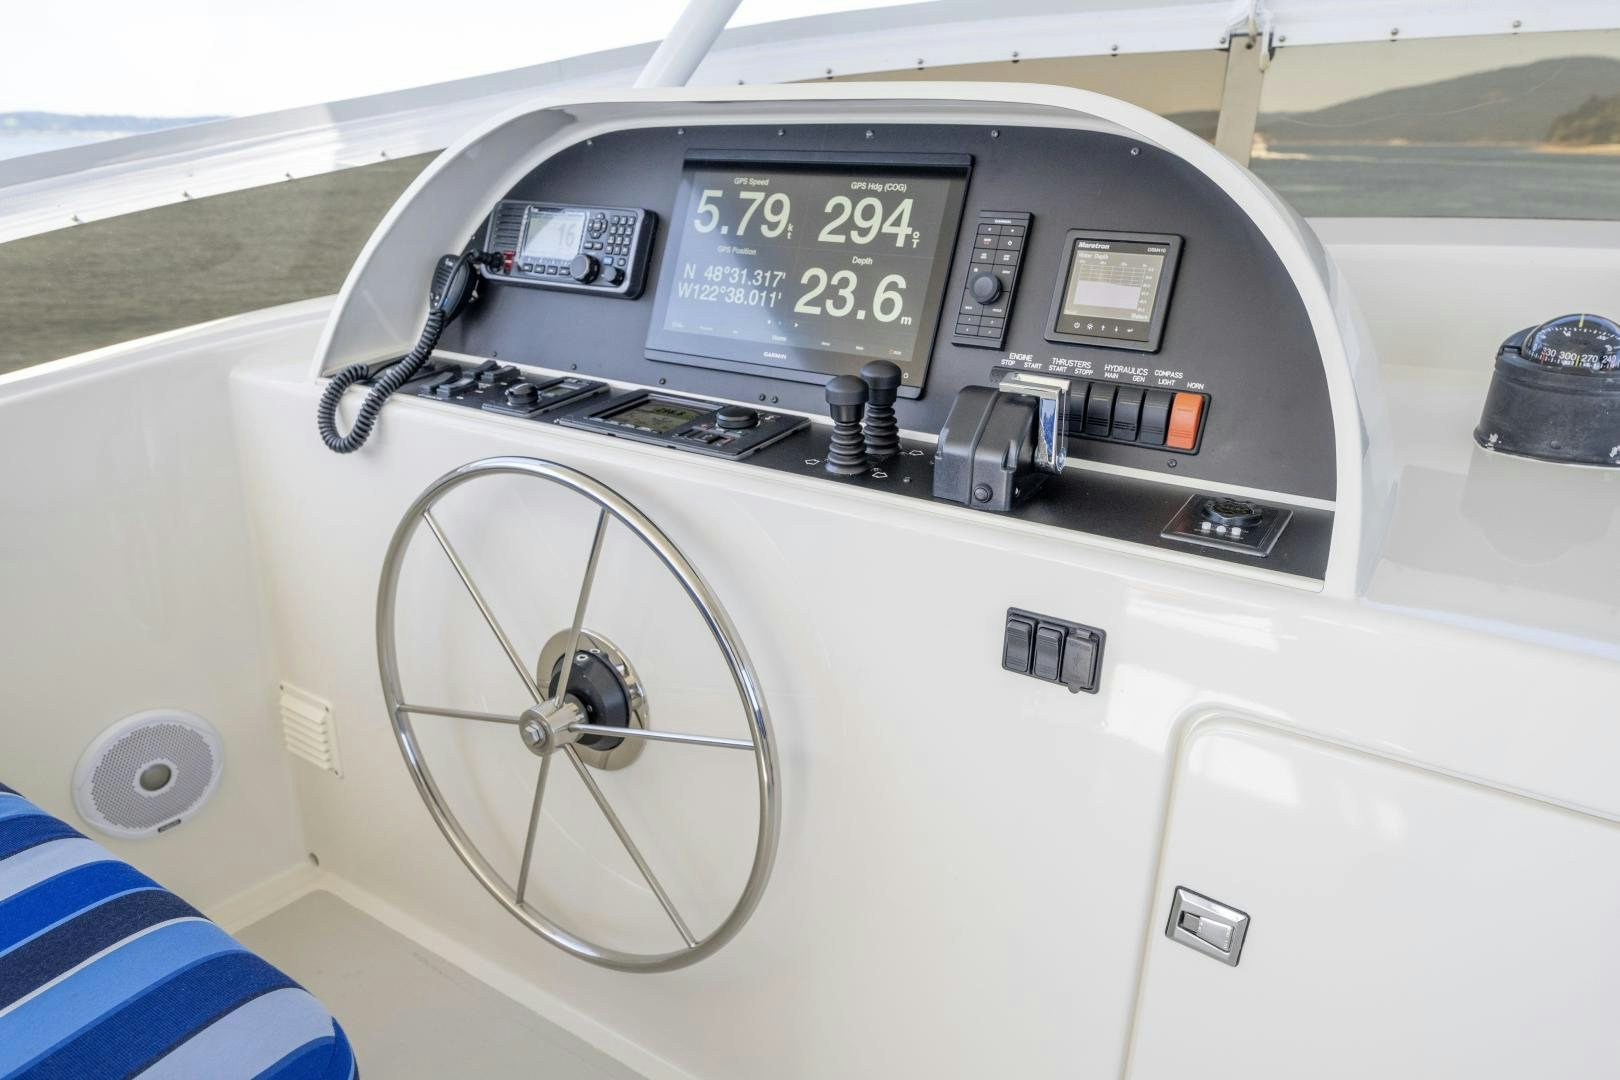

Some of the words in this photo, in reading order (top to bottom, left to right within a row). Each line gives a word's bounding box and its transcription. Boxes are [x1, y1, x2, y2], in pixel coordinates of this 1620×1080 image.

[734, 177, 748, 185] GPS
[749, 178, 769, 187] Speed
[851, 182, 867, 190] GPS
[868, 183, 883, 192] Hdg
[884, 183, 907, 192] (COG)
[694, 189, 791, 238] 5.79
[818, 195, 914, 248] 294
[732, 247, 757, 255] Position
[852, 256, 873, 265] Depth
[684, 263, 696, 279] N
[794, 267, 907, 323] 23.6
[901, 316, 912, 325] m
[1009, 352, 1033, 361] ENGINE
[1559, 351, 1577, 361] 300
[1581, 354, 1598, 363] 270
[1052, 357, 1092, 369] THRUSTERS
[1048, 365, 1067, 373] START
[1104, 363, 1149, 376] HYDRAULICS
[1154, 369, 1184, 379] COMPASS
[1158, 378, 1176, 386] LIGHT
[1186, 382, 1205, 390] HORN
